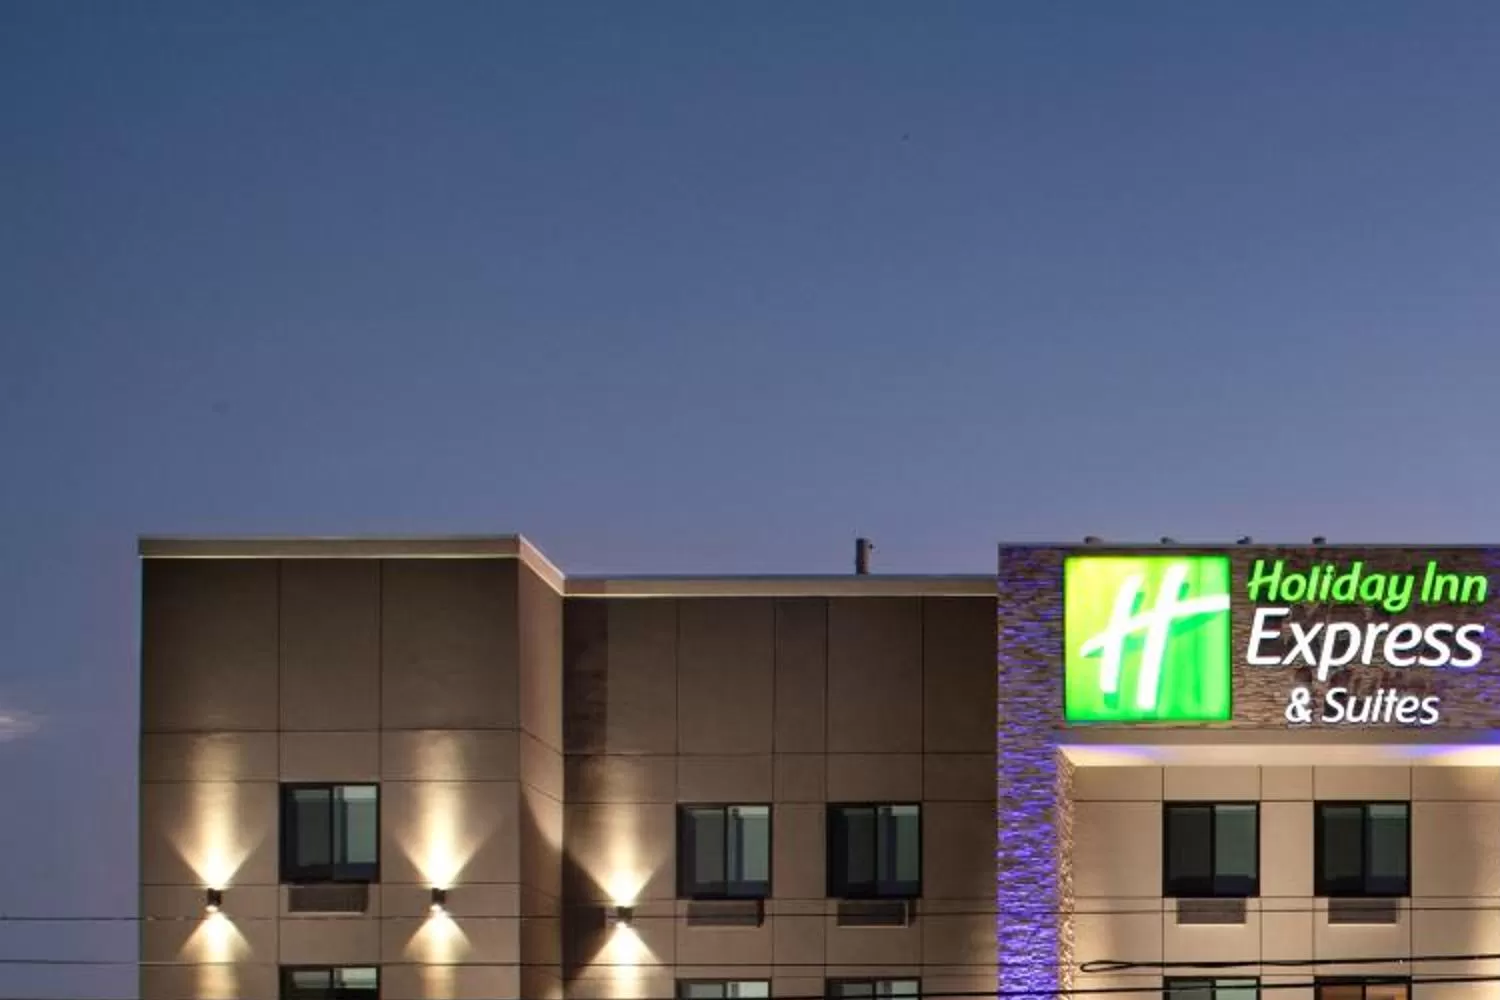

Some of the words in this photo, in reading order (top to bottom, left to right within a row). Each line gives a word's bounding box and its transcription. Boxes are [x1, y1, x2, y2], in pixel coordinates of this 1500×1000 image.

[1247, 559, 1415, 613] Holiday
[1420, 560, 1488, 603] Inn
[1246, 607, 1486, 681] Express
[1284, 687, 1313, 723] &
[1321, 687, 1441, 725] Suites
